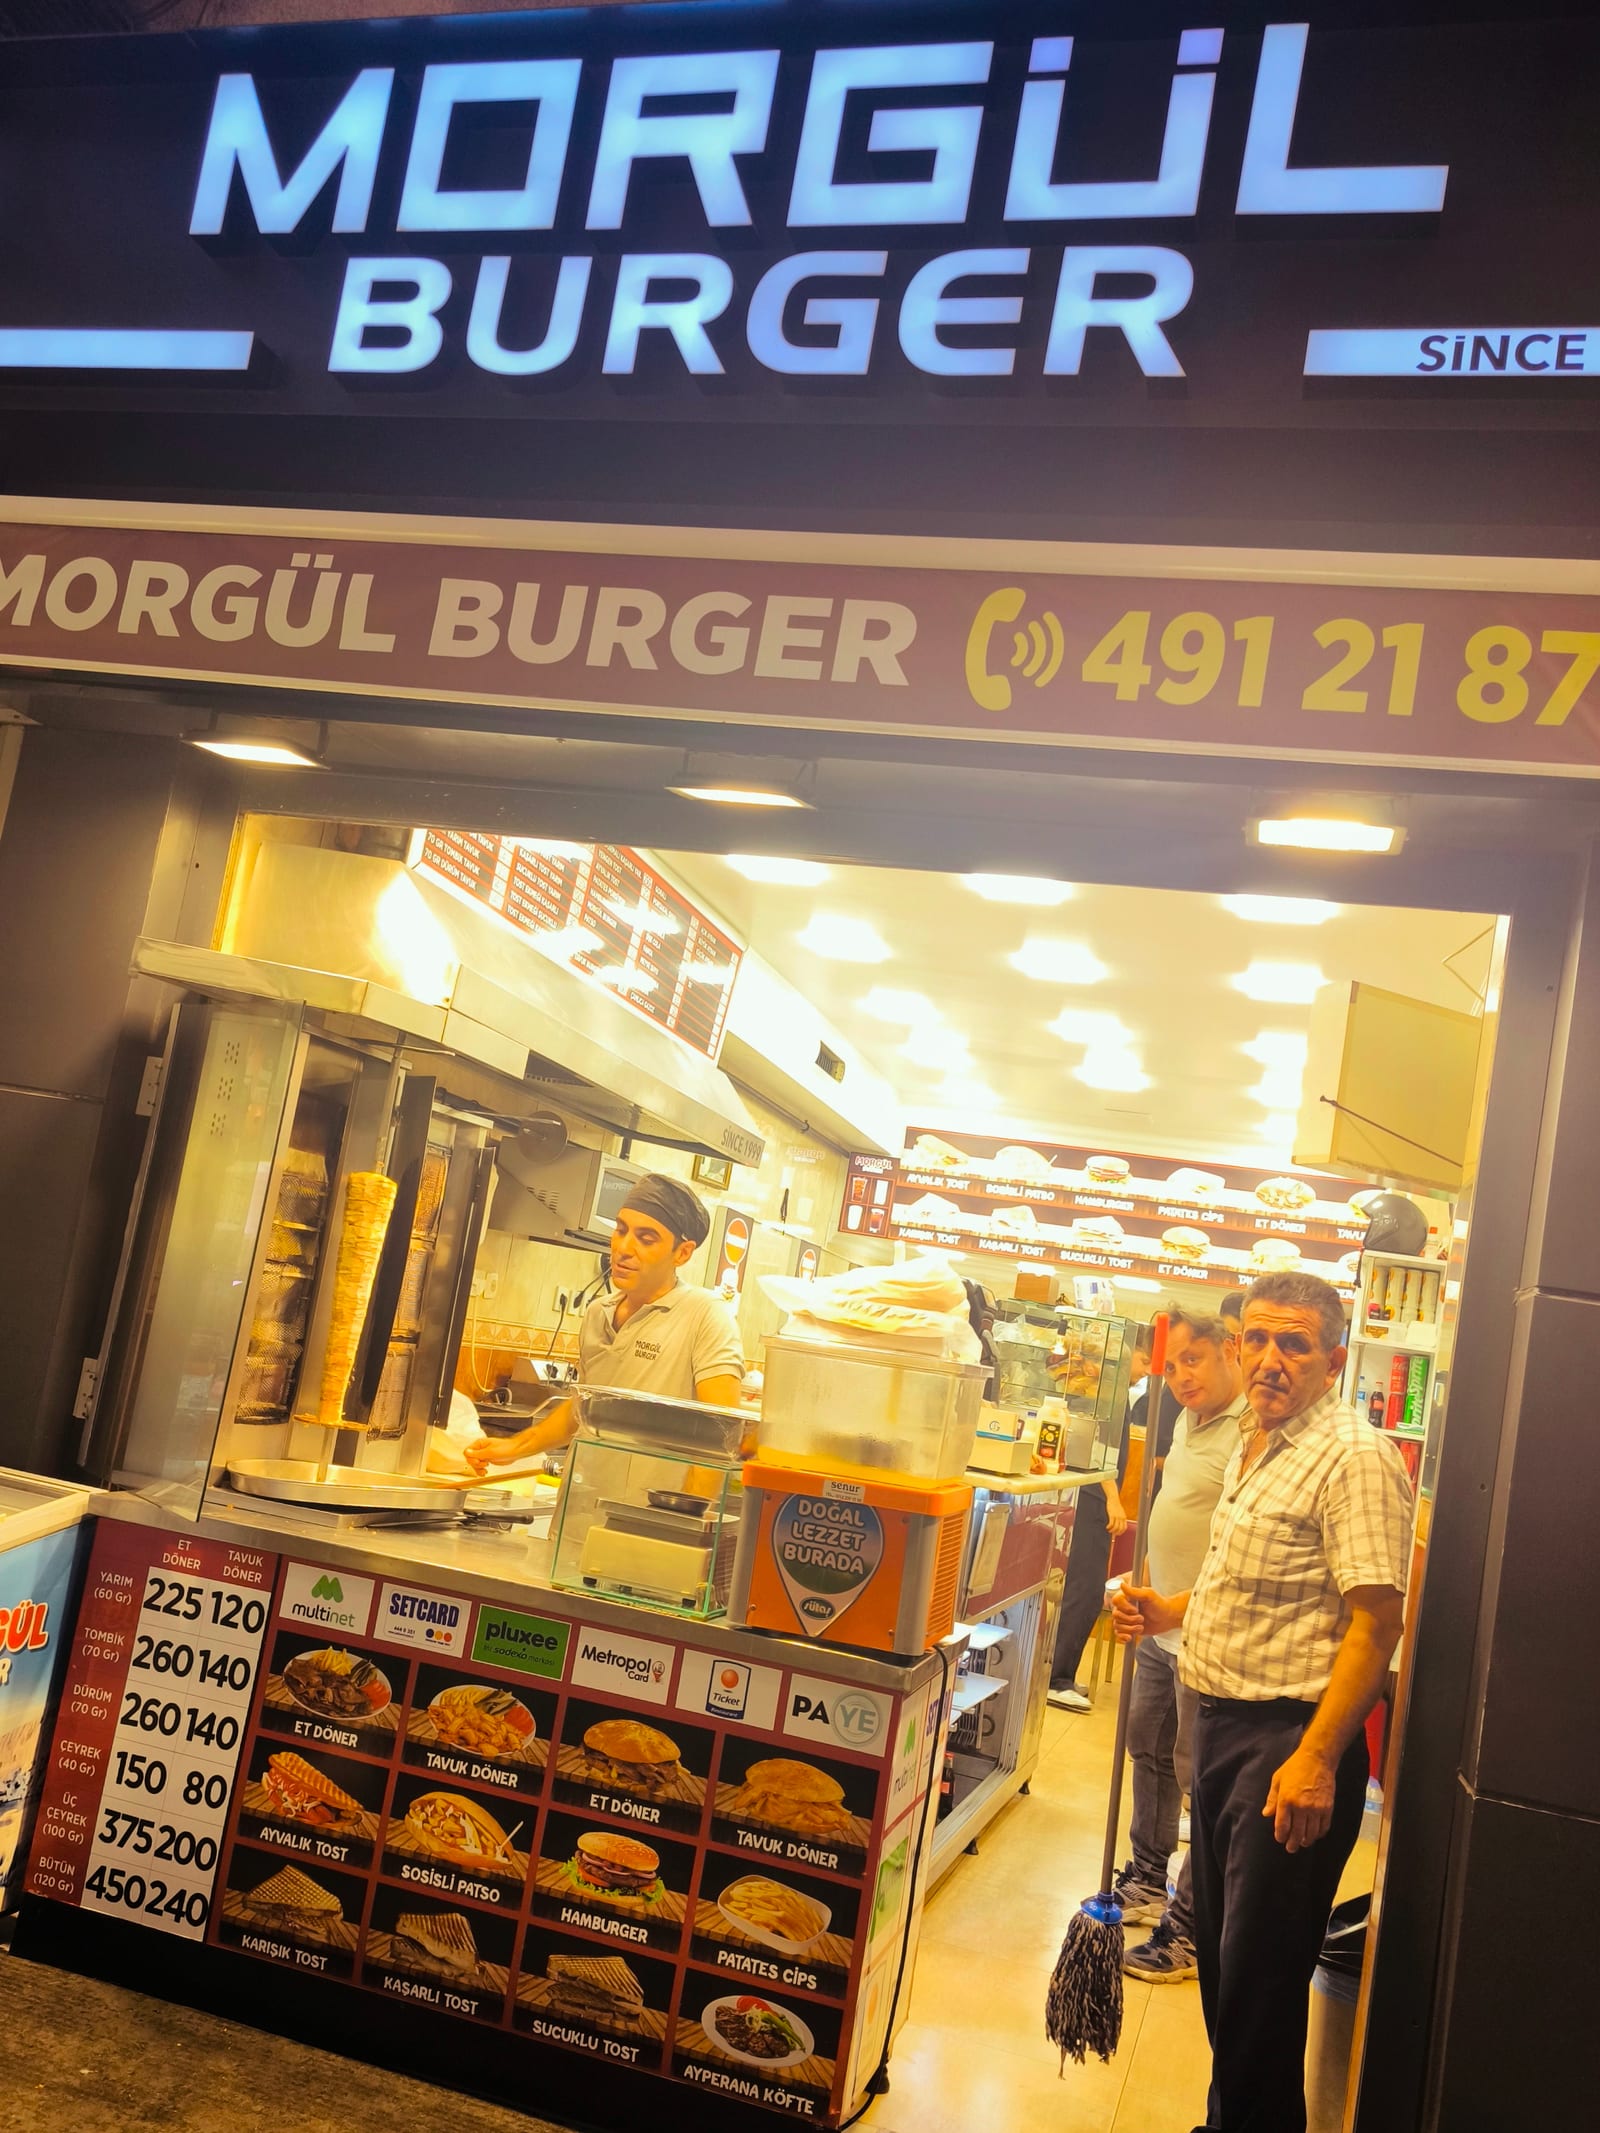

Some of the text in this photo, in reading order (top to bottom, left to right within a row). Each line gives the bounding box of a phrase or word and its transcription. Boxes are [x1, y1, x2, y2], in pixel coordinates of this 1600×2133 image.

[189, 23, 1449, 234] MORGÜL
[328, 245, 1194, 377] BURGER
[0, 553, 1600, 726] MORGÜL BURGER 491 21 87
[946, 1178, 970, 1190] TOST
[937, 1233, 960, 1245] TOST
[1255, 1219, 1307, 1234] ET DÖNER
[1337, 1228, 1366, 1242] TAVU
[1021, 1245, 1046, 1258] TOST
[1108, 1256, 1134, 1269] TOST
[1158, 1264, 1209, 1280] ET DÖNER
[635, 1350, 657, 1361] BURGER
[798, 1500, 865, 1527] DOĞAL
[178, 1539, 192, 1551] ET
[792, 1522, 866, 1551] LEZZET
[162, 1552, 201, 1571] DÖNER
[228, 1550, 264, 1567] TAVUK
[783, 1544, 864, 1576] BURADA
[100, 1571, 134, 1588] YARIM
[222, 1565, 262, 1584] DÖNER
[94, 1587, 132, 1606] (60 Gr)
[143, 1577, 265, 1634] 225 120
[292, 1602, 356, 1628] multinet
[389, 1592, 460, 1628] SETCARD
[84, 1627, 125, 1646] TOMBİK
[485, 1621, 559, 1651] pluxee
[82, 1644, 120, 1663] (70 Gr)
[132, 1635, 251, 1691] 260 140
[581, 1644, 652, 1673] Metropol
[628, 1670, 649, 1683] Card
[73, 1683, 112, 1703] DÜRÜM
[713, 1692, 740, 1706] Ticket
[71, 1702, 108, 1720] (70 Gr)
[120, 1692, 239, 1750] 260 140
[294, 1720, 358, 1748] ET DÖNER
[60, 1739, 101, 1759] ÇEYREK
[58, 1757, 96, 1777] (40 Gr)
[116, 1751, 228, 1809] 150 80
[426, 1752, 518, 1788] TAVUK DÖNER
[62, 1792, 77, 1808] ÜÇ
[589, 1794, 661, 1823] ET DÖNER
[46, 1806, 88, 1827] ÇEYREK
[42, 1823, 84, 1845] (100 Gr)
[98, 1808, 217, 1871] 375 200
[259, 1827, 349, 1862] AYVALIK TOST
[736, 1830, 839, 1869] TAVUK DÖNER
[39, 1856, 75, 1877] BÜTÜN
[33, 1872, 75, 1895] (120 Gr)
[85, 1865, 208, 1927] 450 240
[401, 1865, 501, 1903] SOSİSLİ PATSO
[561, 1907, 648, 1944] HAMBURGER
[241, 1934, 328, 1971] KARIŞIK TOST
[717, 1950, 817, 1990] PATATES CİPS
[384, 1976, 478, 2015] KAŞARLI TOST
[532, 2020, 640, 2063] SUCUKLU TOST
[683, 2064, 815, 2115] AYPERANA KÖFTE
